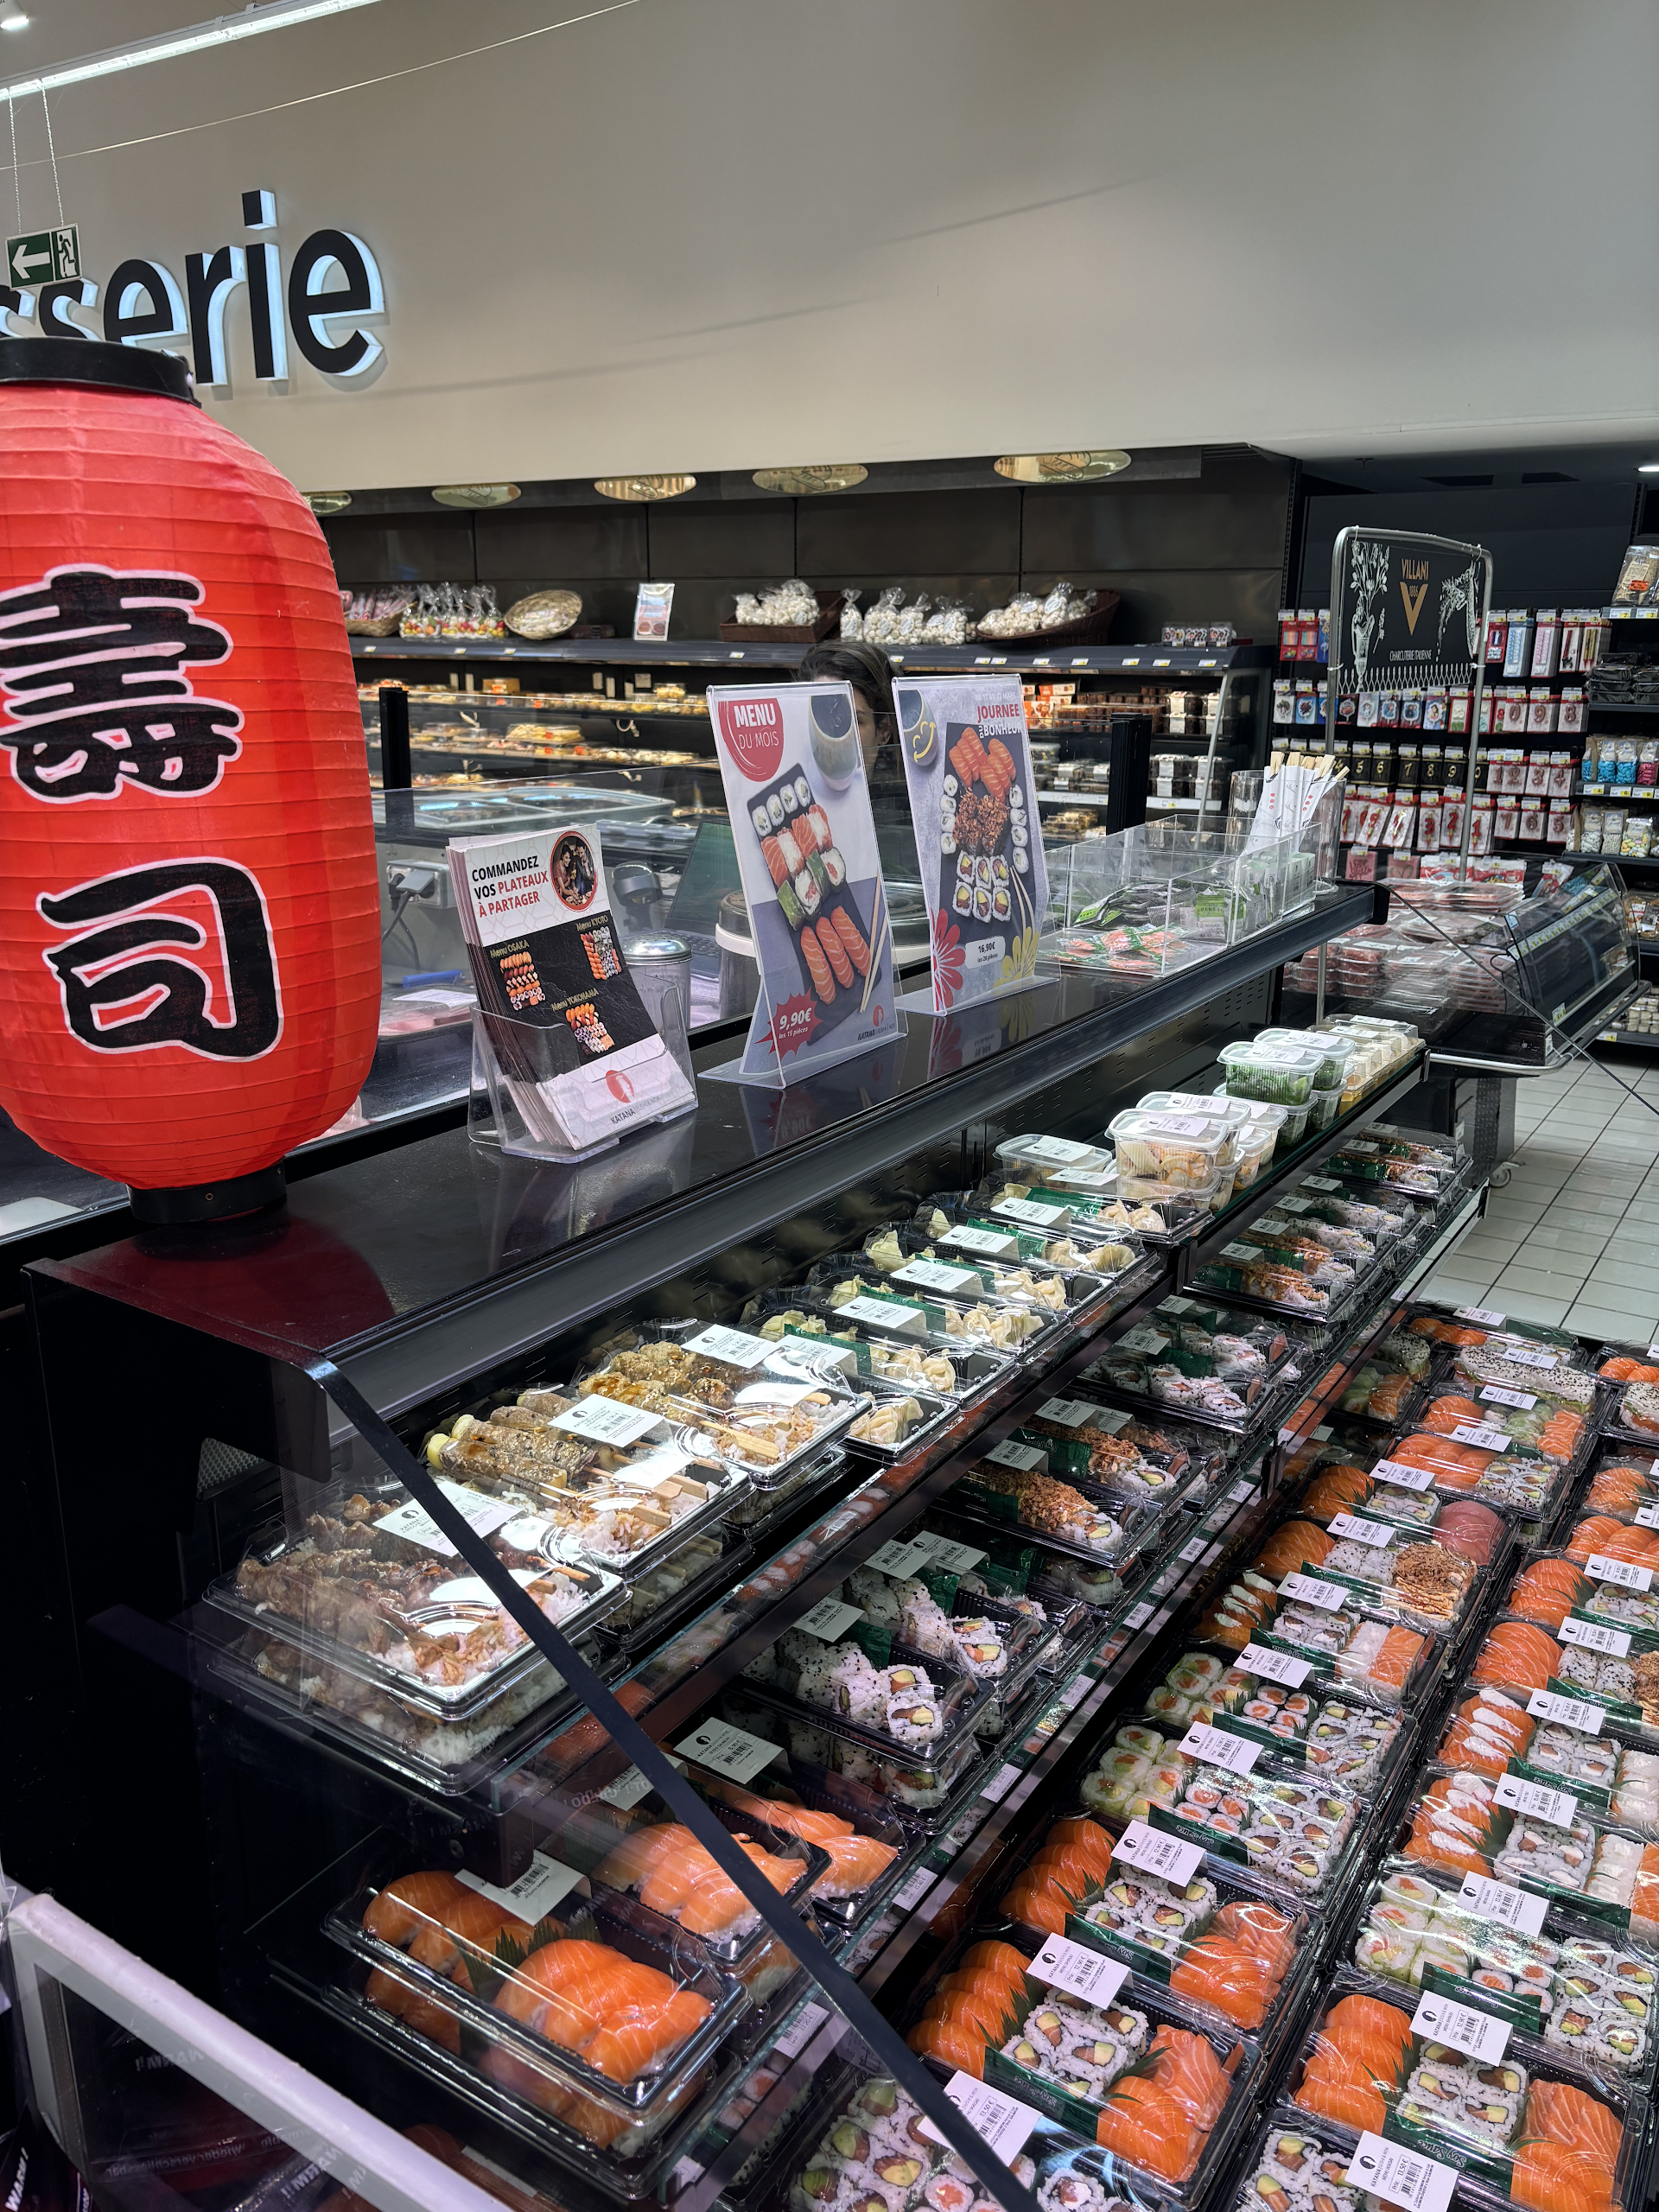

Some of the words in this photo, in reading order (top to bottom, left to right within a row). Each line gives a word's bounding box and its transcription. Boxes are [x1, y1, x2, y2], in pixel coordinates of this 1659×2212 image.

[1401, 558, 1429, 581] VILLANI
[1389, 650, 1414, 661] CHARCUTERIE
[1414, 649, 1432, 660] ITALIENNE
[734, 703, 776, 728] MENU
[977, 703, 1020, 723] JOURNEE
[1534, 704, 1546, 723] 9
[1565, 704, 1576, 723] 8
[984, 722, 1022, 736] BONHEUR
[739, 734, 753, 749] DU
[755, 731, 779, 747] MOIS
[1356, 760, 1363, 774] 5
[1376, 761, 1384, 774] 6
[1404, 763, 1412, 776] 7
[1427, 764, 1434, 777] 8
[1447, 765, 1457, 778] 9
[1509, 766, 1522, 785] 2
[1532, 767, 1544, 786] 3
[1425, 817, 1435, 835] 3
[1447, 811, 1459, 830] 2
[1472, 819, 1482, 837] 1
[1525, 811, 1538, 830] 6
[1554, 816, 1565, 833] 5
[472, 855, 539, 881] COMMANDEZ
[474, 884, 496, 899] VOS
[498, 871, 549, 893] PLATEAUX
[478, 902, 487, 918] À
[488, 892, 540, 915] PARTAGER
[575, 921, 591, 931] Menu
[591, 915, 608, 927] KYOTO
[490, 946, 507, 958] Menu
[508, 940, 530, 952] OSAKA
[551, 1000, 568, 1011] Menu
[779, 1007, 811, 1030] 9,90€
[793, 1027, 808, 1036] pièces
[857, 1029, 875, 1040] KATANA
[610, 1108, 636, 1124] KATANA
[1131, 1847, 1141, 1860] KATANA
[1048, 1962, 1060, 1978] KATANA
[1074, 1959, 1083, 1969] 12,90
[1433, 2020, 1442, 2037] KATANA
[1014, 2075, 1040, 2096] Sauce
[1039, 2088, 1058, 2107] Soy
[980, 2103, 991, 2117] 13,50
[1418, 2139, 1447, 2159] Sauce
[1446, 2150, 1466, 2168] Soy
[1370, 2169, 1381, 2187] KATANA
[1397, 2164, 1407, 2176] 13,50
